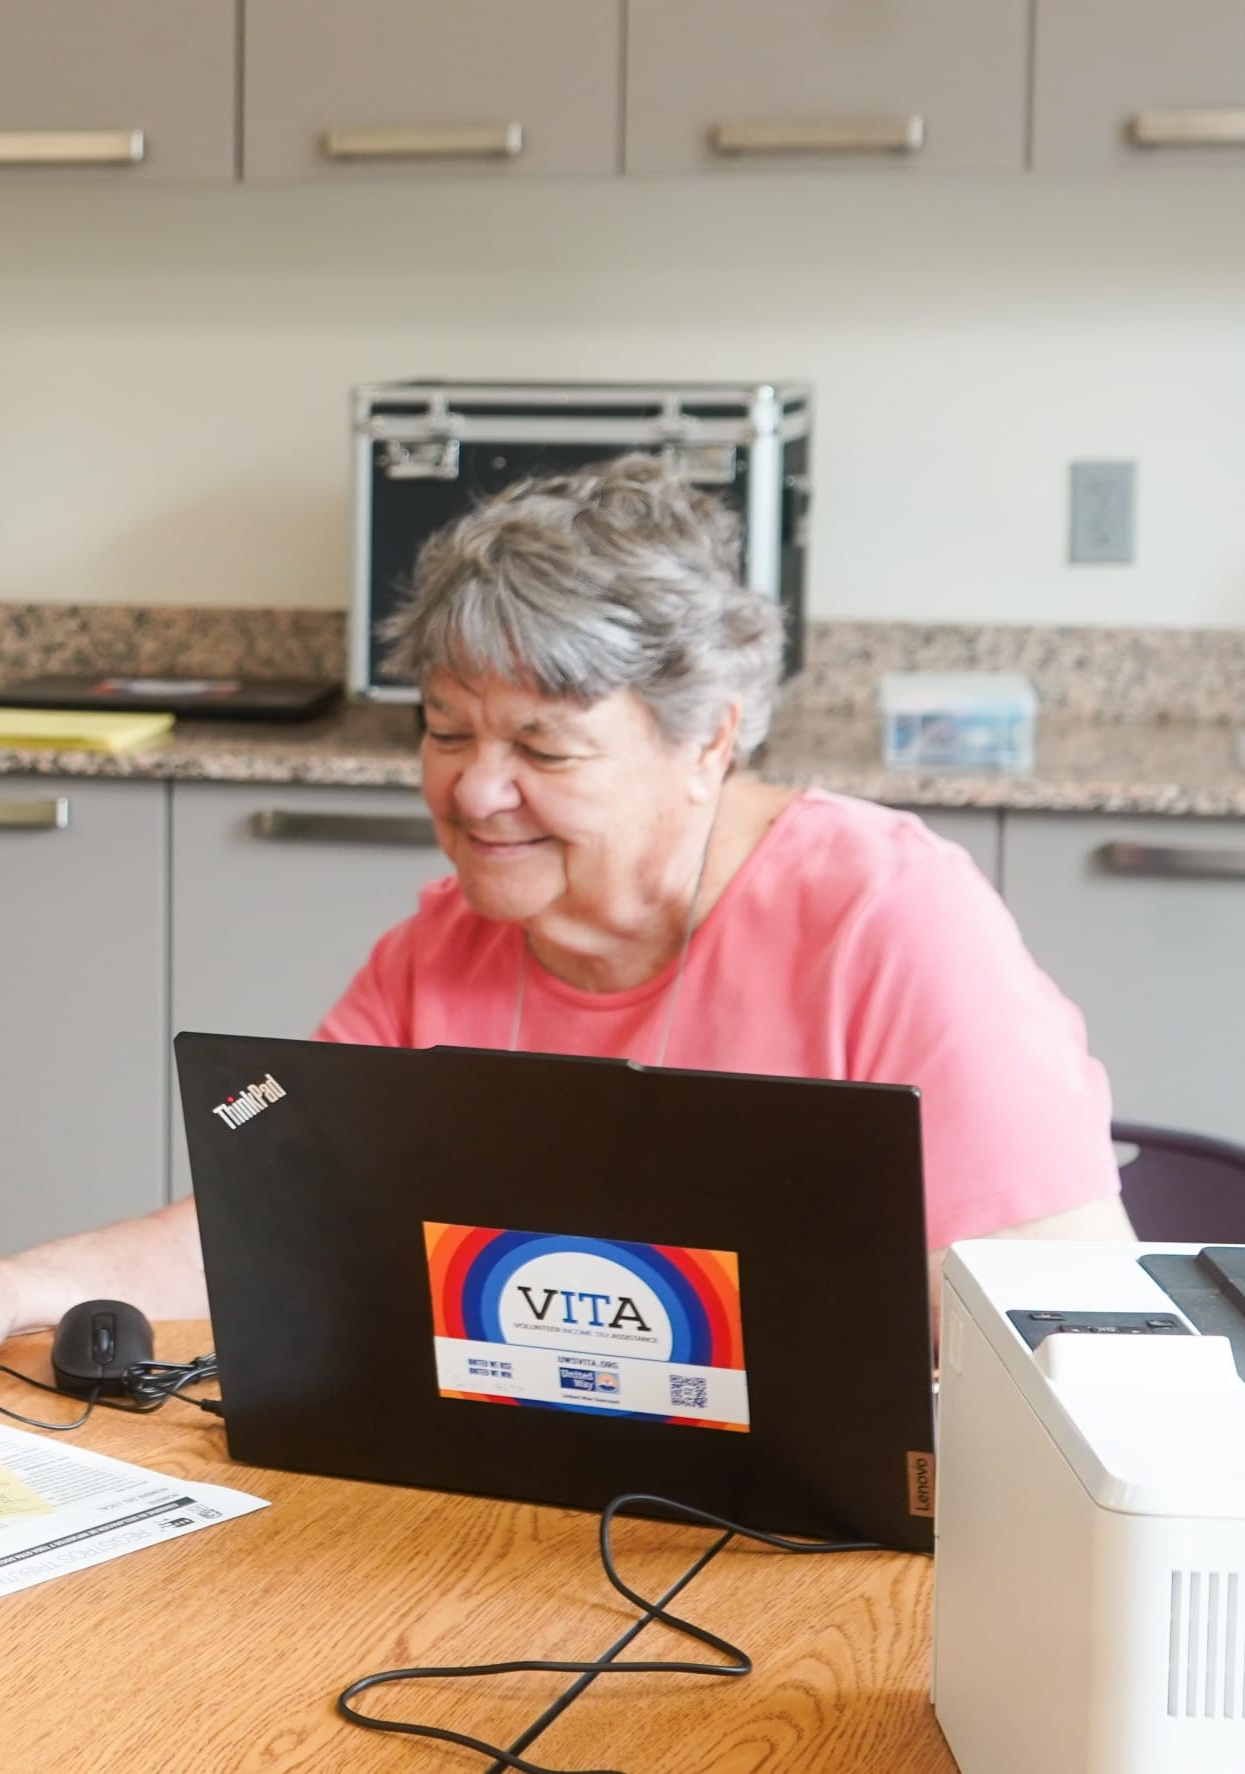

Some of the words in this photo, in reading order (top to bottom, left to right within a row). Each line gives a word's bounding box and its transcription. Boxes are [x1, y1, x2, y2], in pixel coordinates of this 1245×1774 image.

[212, 1073, 287, 1129] ThinkPad
[517, 1285, 652, 1332] VITA
[561, 1368, 594, 1380] United
[573, 1379, 594, 1391] Way
[915, 1458, 929, 1511] Lenovo
